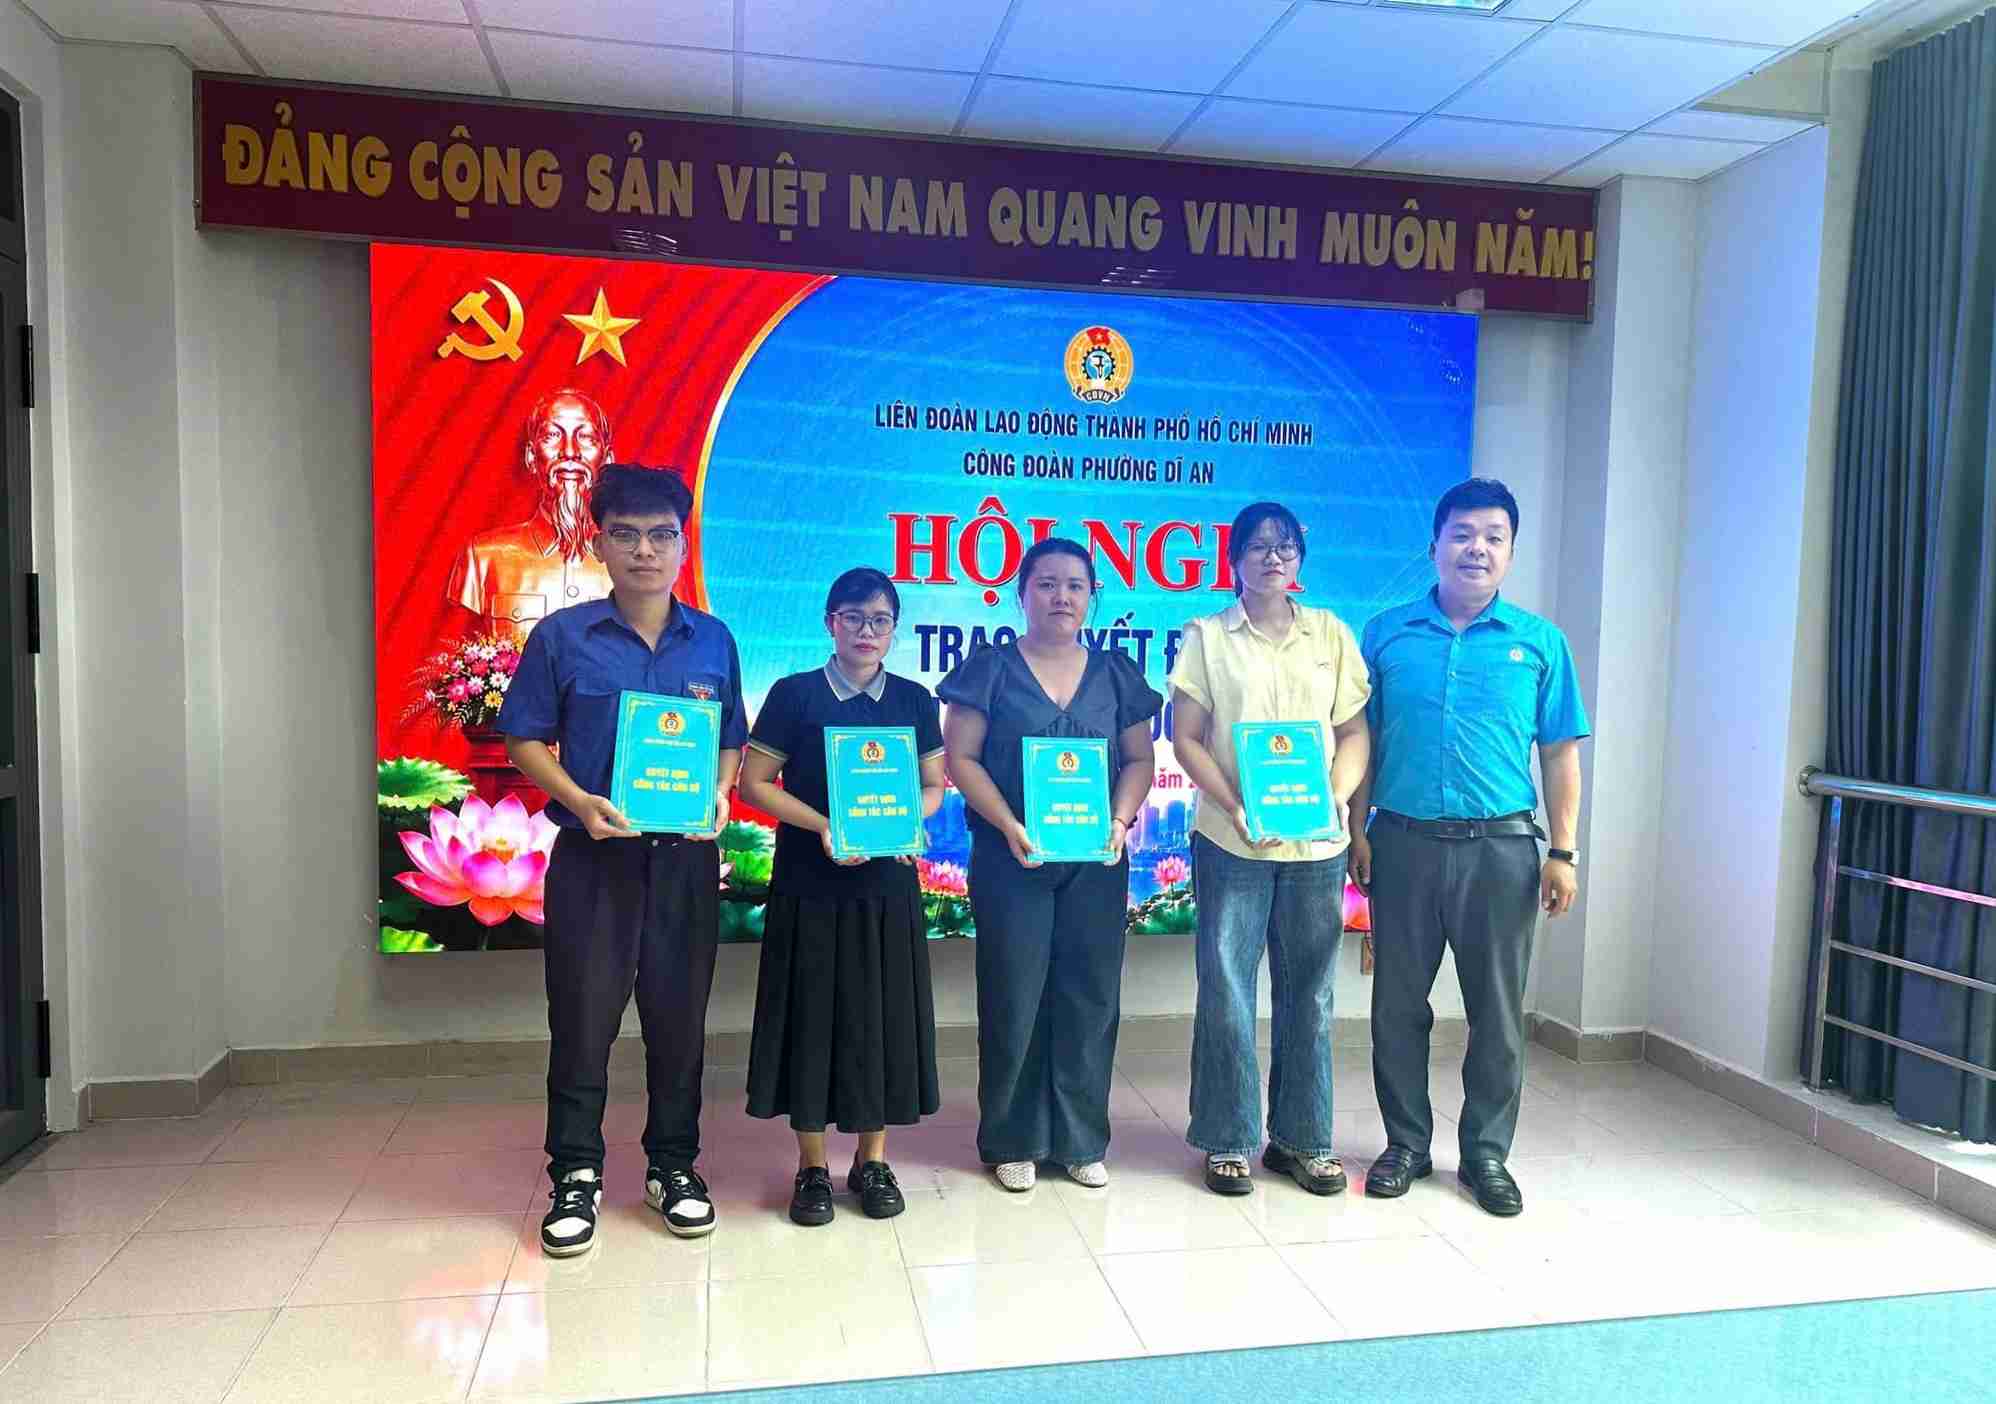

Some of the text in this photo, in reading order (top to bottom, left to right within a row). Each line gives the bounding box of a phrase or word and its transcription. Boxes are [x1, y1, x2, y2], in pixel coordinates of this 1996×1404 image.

[222, 101, 1594, 280] ĐẢNG CỘNG SẢN VIỆT NAM QUANG VINH MUÔN NĂM!
[875, 400, 1314, 446] LIÊN ĐOÀN LAO ĐỘNG THÀNH PHỐ HỒ CHÍ MINH
[963, 448, 1215, 485] CÔNG ĐOÀN PHƯỜNG DĨ AN
[1082, 519, 1308, 593] NG
